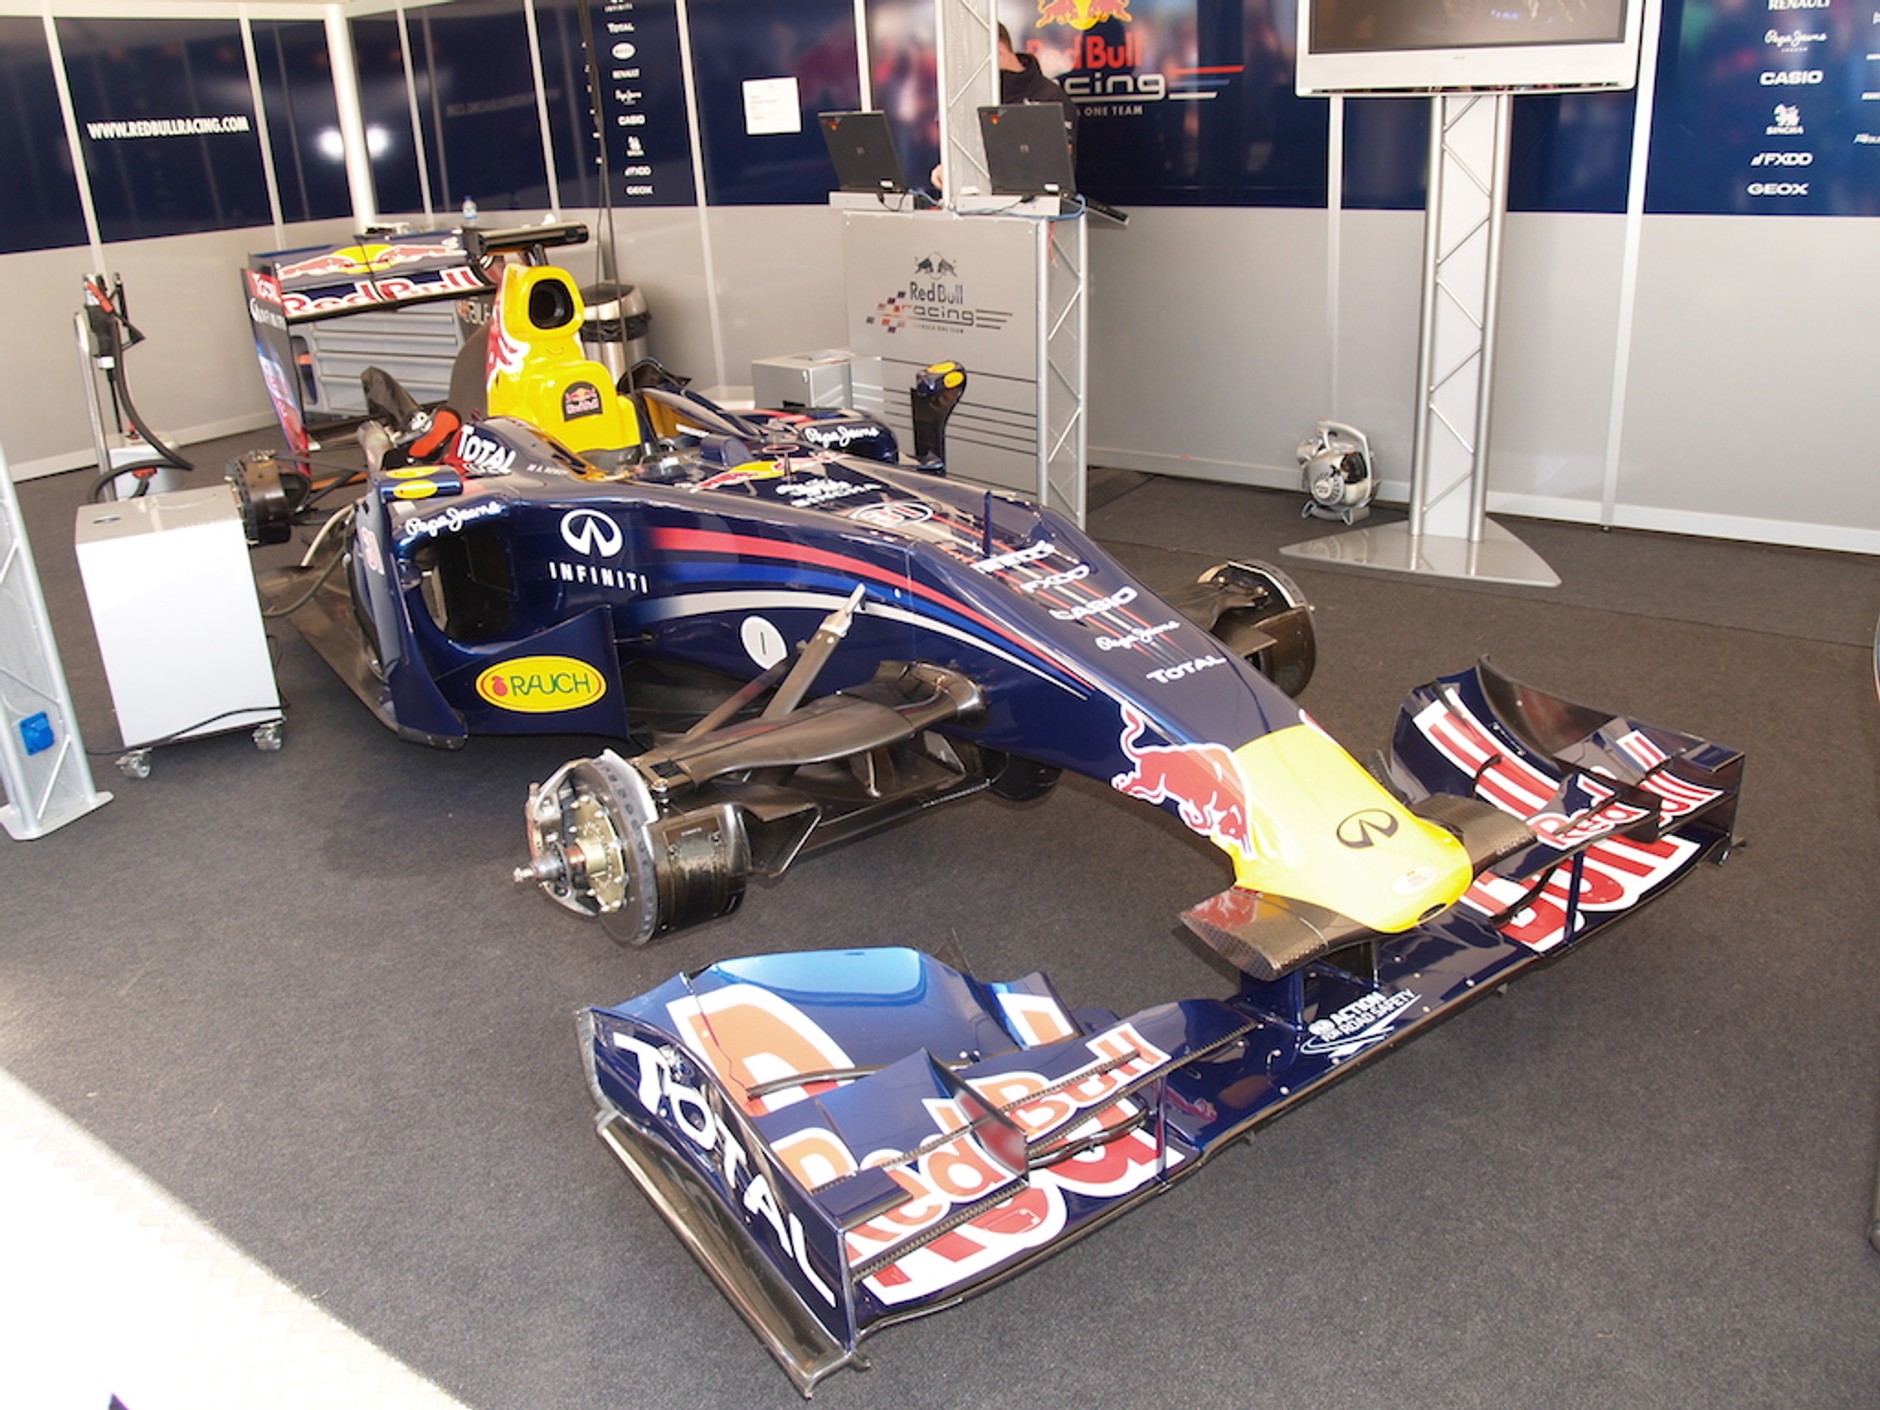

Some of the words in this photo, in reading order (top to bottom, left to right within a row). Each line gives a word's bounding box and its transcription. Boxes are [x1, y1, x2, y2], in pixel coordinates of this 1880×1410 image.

[1086, 31, 1143, 68] Bull
[1760, 71, 1823, 85] CASIO
[618, 114, 646, 126] CASIO
[1084, 106, 1108, 117] ONE
[1112, 104, 1144, 116] TEAM
[87, 115, 250, 140] WWW.REDBULLRACING.COM
[1748, 183, 1809, 195] GEOX
[281, 280, 387, 318] Red
[377, 266, 484, 300] Bull
[909, 281, 936, 301] Red
[937, 284, 963, 305] Bull
[457, 424, 517, 476] TOTAL
[549, 562, 648, 593] INFINITI
[1049, 586, 1138, 620] CASIO
[1146, 655, 1227, 683] TOTAL
[510, 673, 591, 697] RAUCH
[1330, 991, 1387, 1025] ACTION
[613, 1031, 836, 1308] TOTAL
